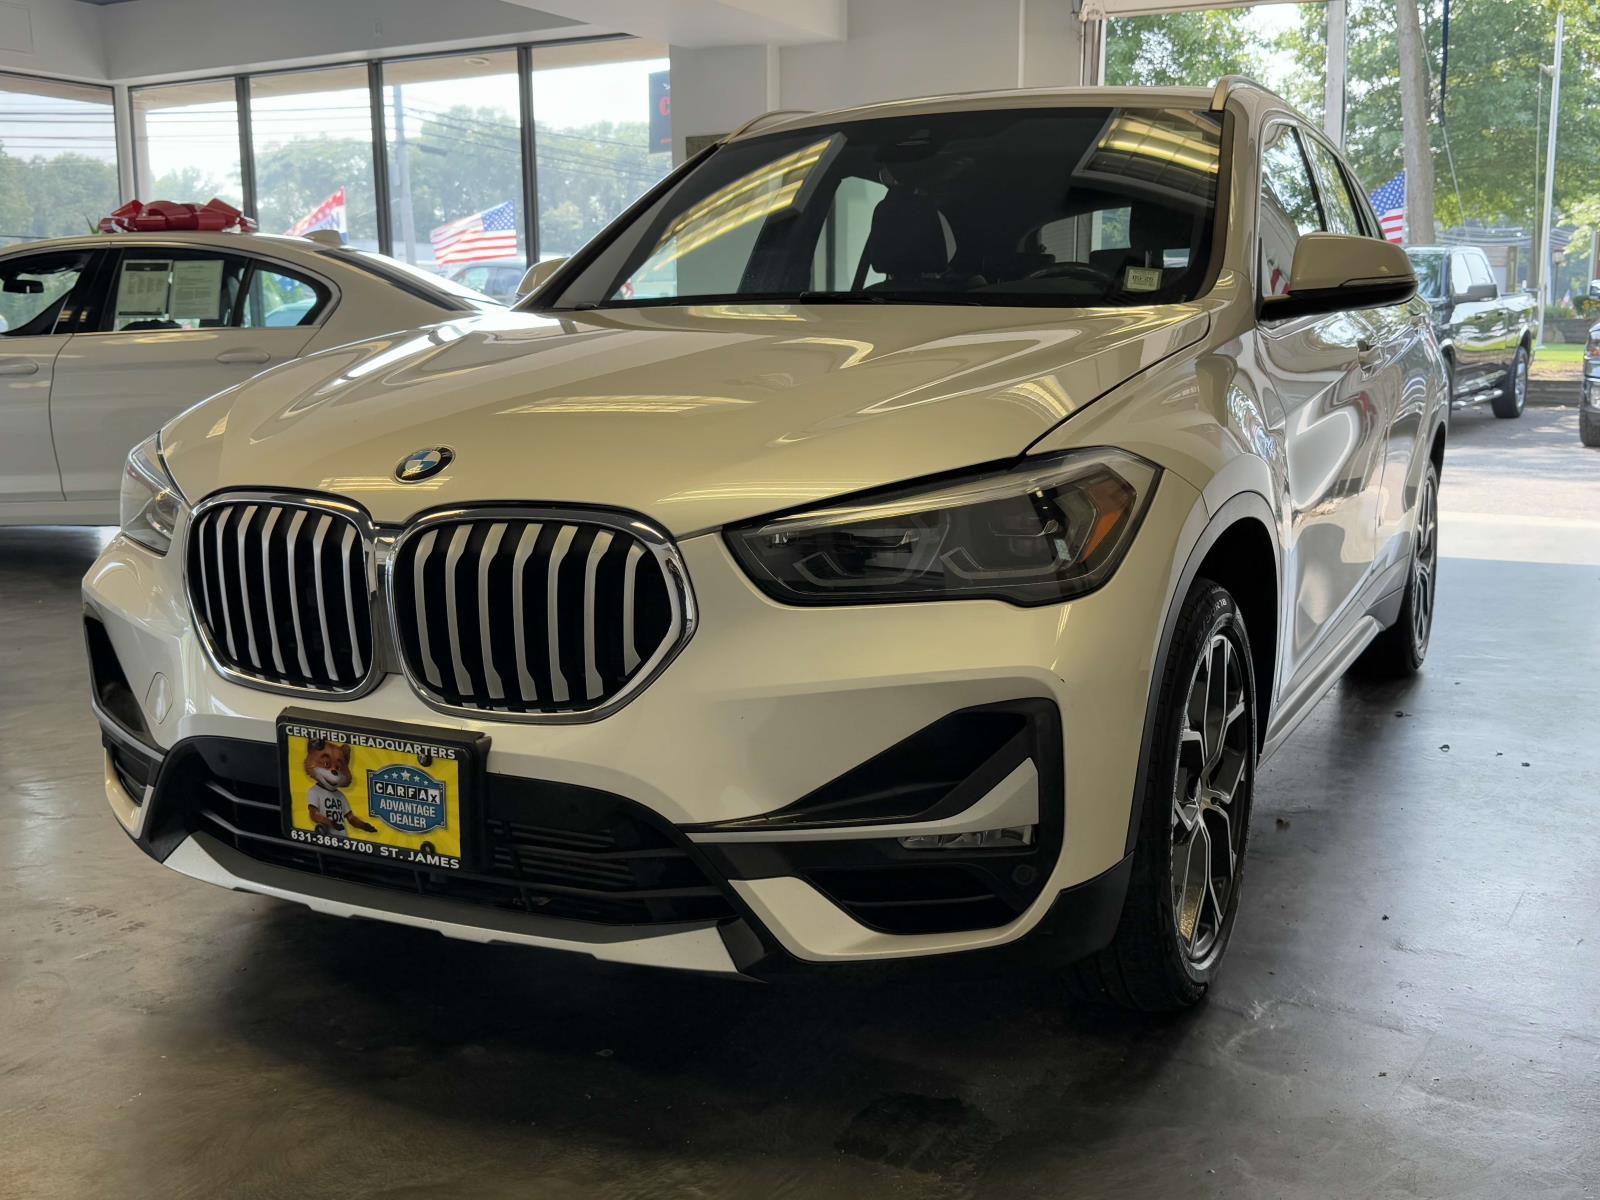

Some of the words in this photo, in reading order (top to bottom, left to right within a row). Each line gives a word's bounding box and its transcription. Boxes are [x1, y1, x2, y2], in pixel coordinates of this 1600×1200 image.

[285, 725, 347, 743] CERTIFIED
[350, 734, 456, 760] HEADQUARTERS
[375, 782, 439, 804] CARFAX
[379, 799, 436, 817] ADVANTAGE
[389, 812, 427, 829] DEALER
[290, 829, 374, 854] 631-366-3700
[380, 846, 404, 860] ST.
[407, 851, 460, 869] JAMES
